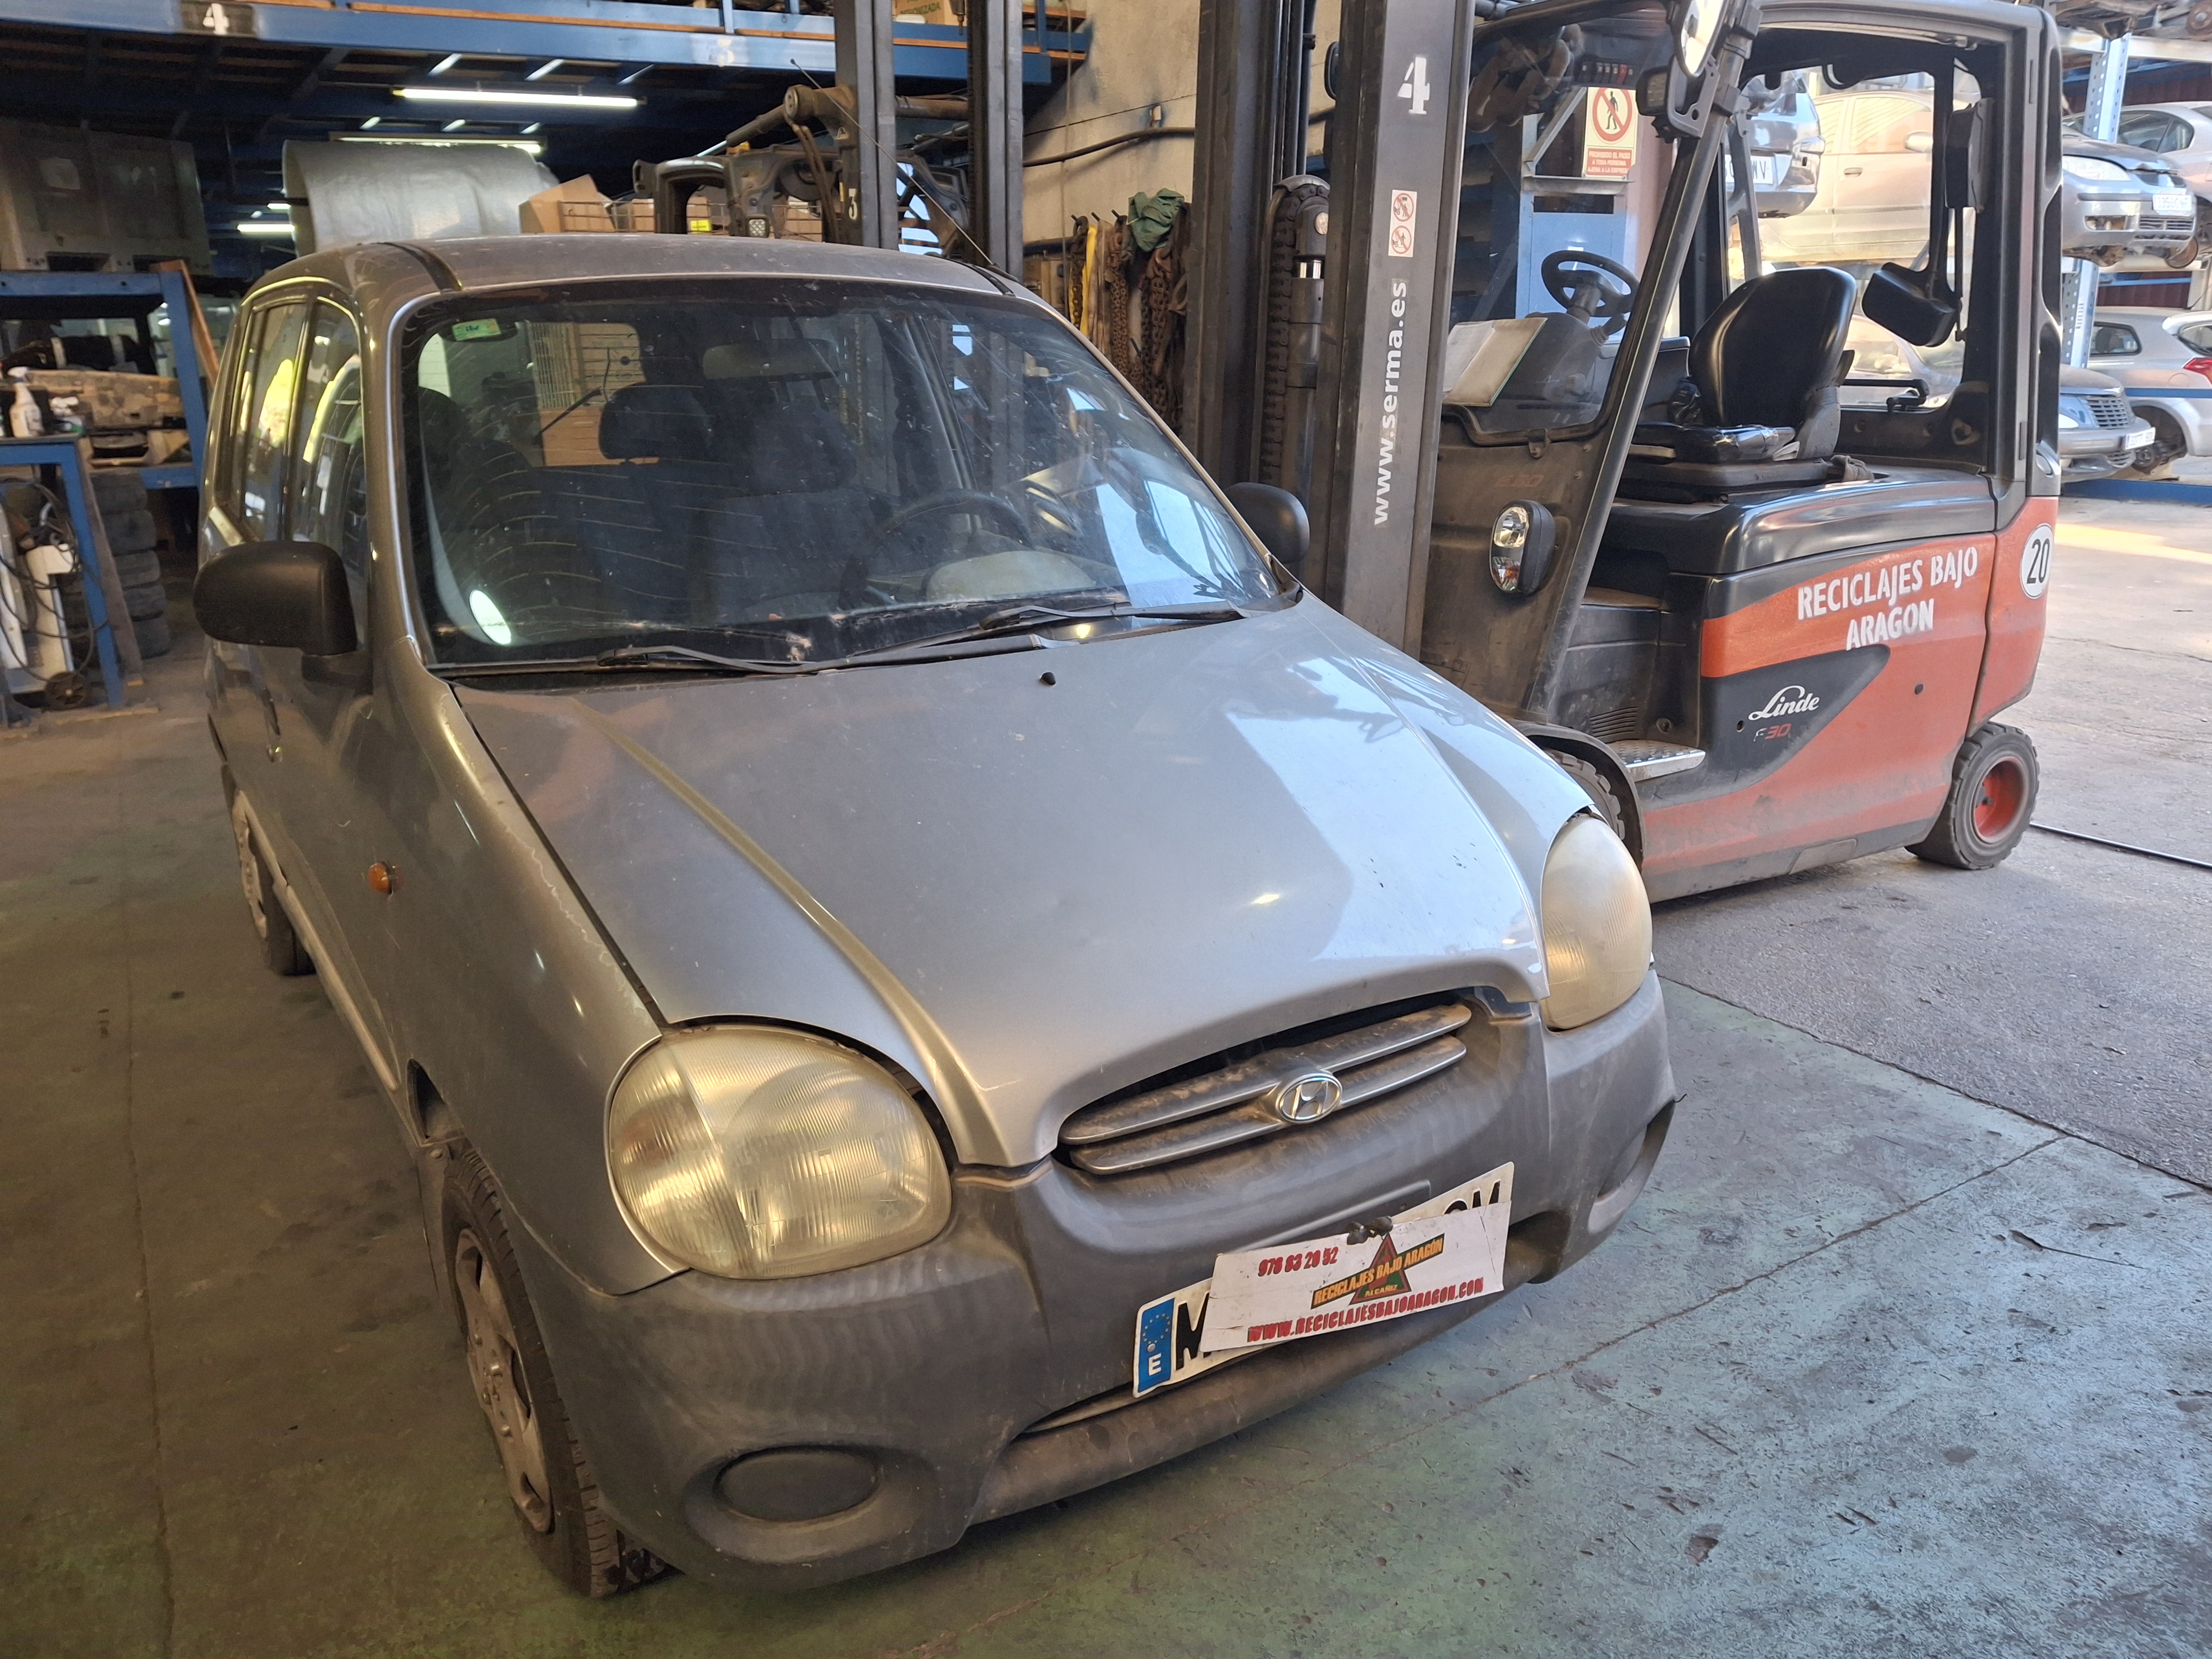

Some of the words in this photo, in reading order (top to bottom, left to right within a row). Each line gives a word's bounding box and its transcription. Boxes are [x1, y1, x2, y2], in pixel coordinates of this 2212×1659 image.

[203, 3, 230, 35] 4
[1398, 56, 1430, 115] 4
[848, 188, 858, 220] 3
[1374, 281, 1407, 526] www.serma.es
[1798, 559, 1924, 621] RECICLAJES
[1930, 546, 1978, 589] BAJO
[2027, 538, 2050, 584] 20
[1846, 597, 1935, 651] ARAGON
[1748, 685, 1820, 721] Linde
[1258, 1256, 1283, 1277] 978
[1284, 1253, 1302, 1272] 83
[1303, 1250, 1321, 1269] 20
[1322, 1246, 1339, 1265] 52
[1313, 1268, 1375, 1306] RECICLAJES
[1376, 1256, 1403, 1280] BAJO
[1247, 1277, 1484, 1342] WWW.RECICLAJESBAJOARAGON.COM
